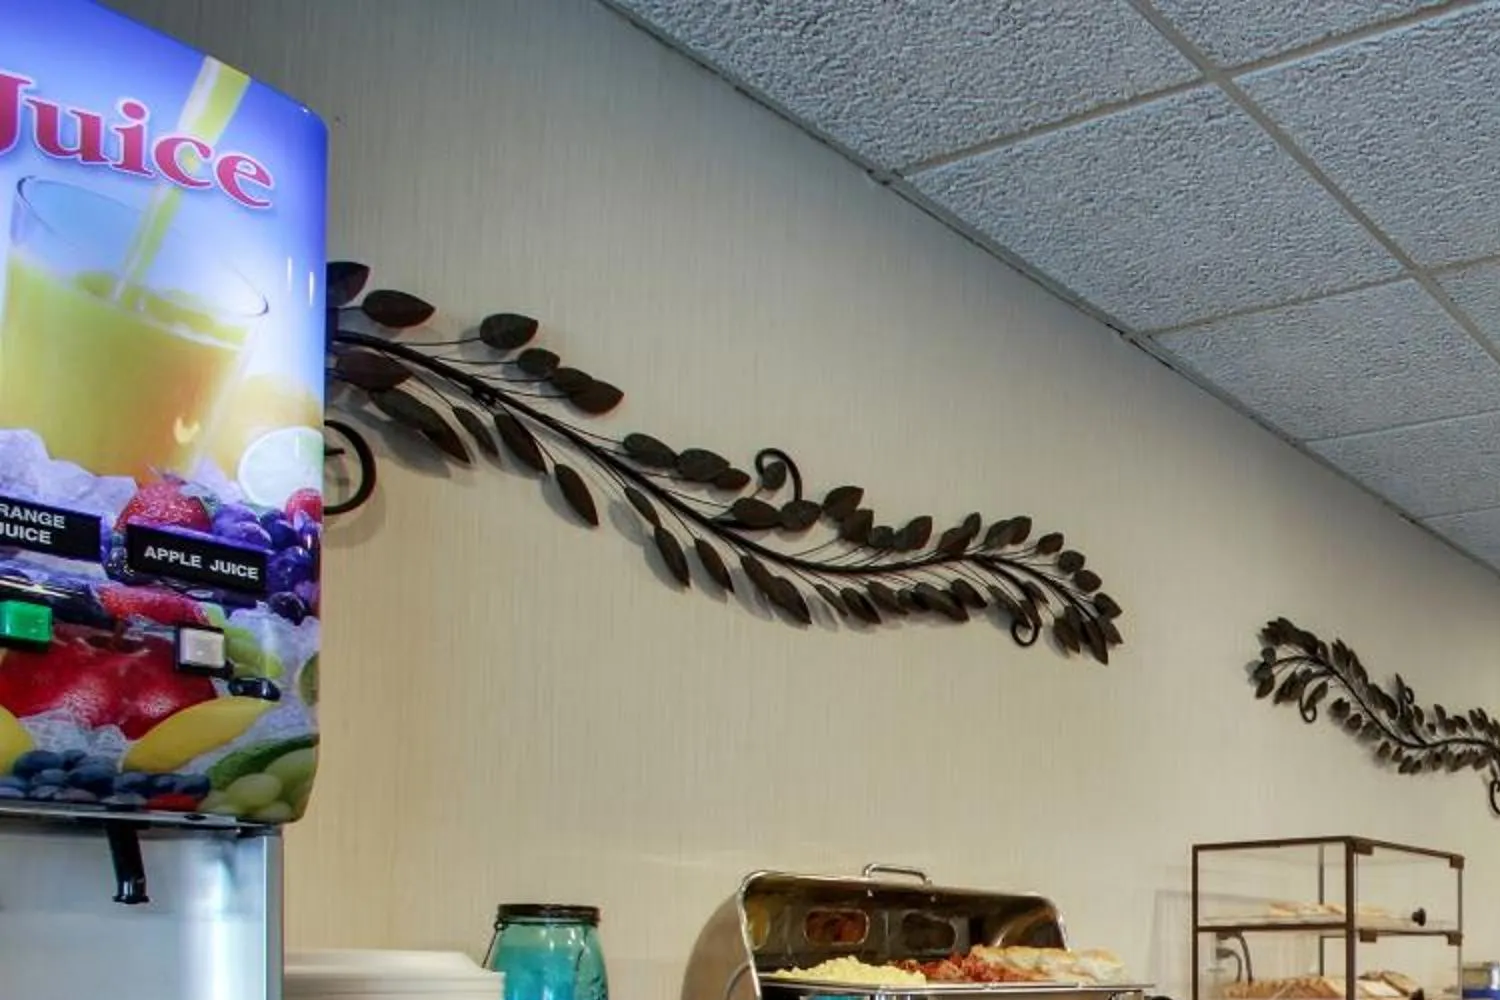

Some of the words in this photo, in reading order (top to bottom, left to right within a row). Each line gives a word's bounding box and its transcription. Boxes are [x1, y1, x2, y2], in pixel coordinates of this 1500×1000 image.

[0, 71, 275, 209] Juice
[143, 545, 203, 569] APPLE
[209, 559, 260, 581] JUICE
